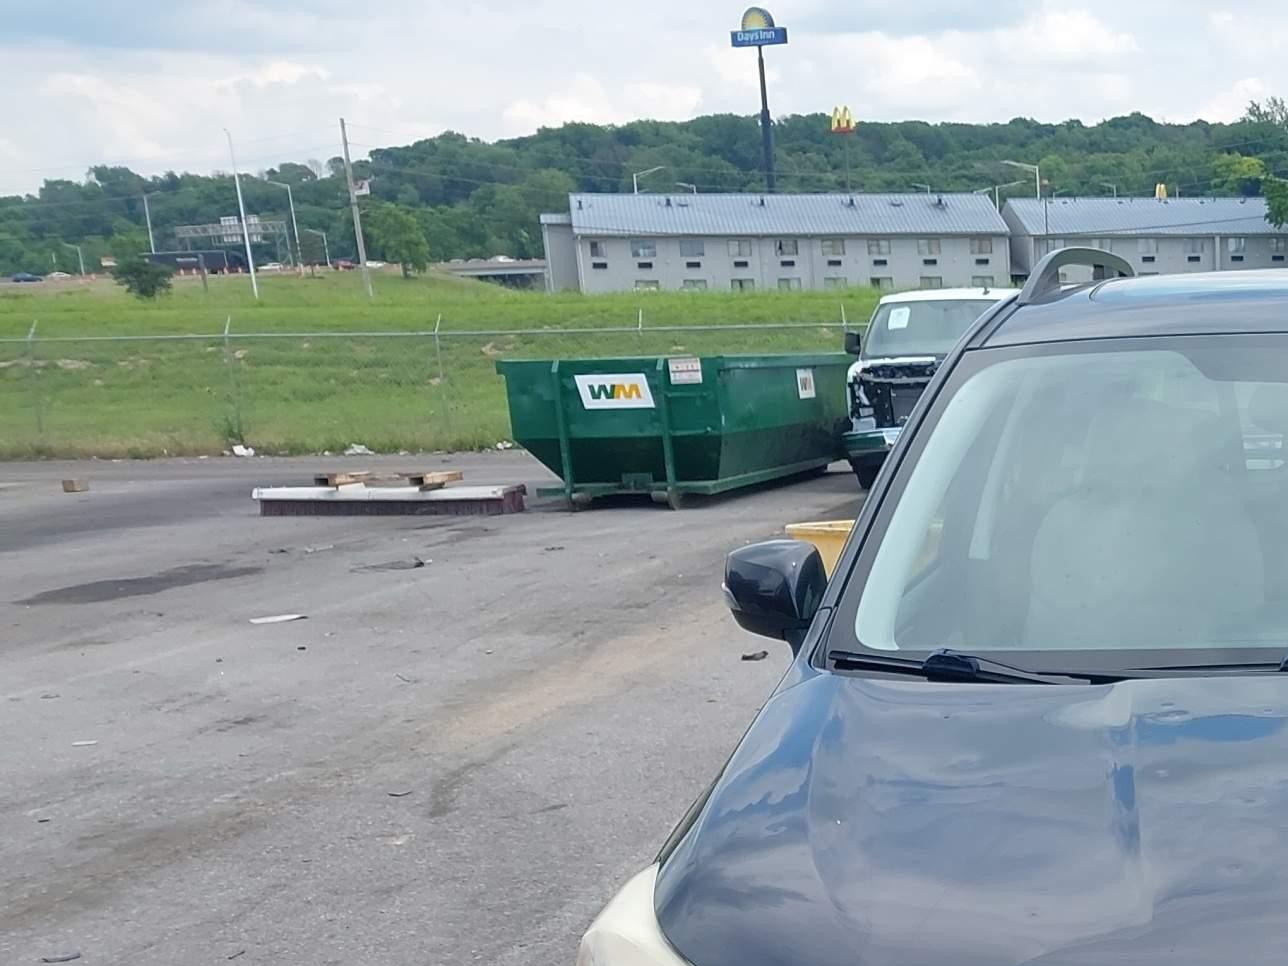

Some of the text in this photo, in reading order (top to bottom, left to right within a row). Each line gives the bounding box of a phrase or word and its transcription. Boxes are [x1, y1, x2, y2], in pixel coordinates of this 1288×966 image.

[737, 30, 775, 42] Days Inn
[587, 384, 642, 400] WM
